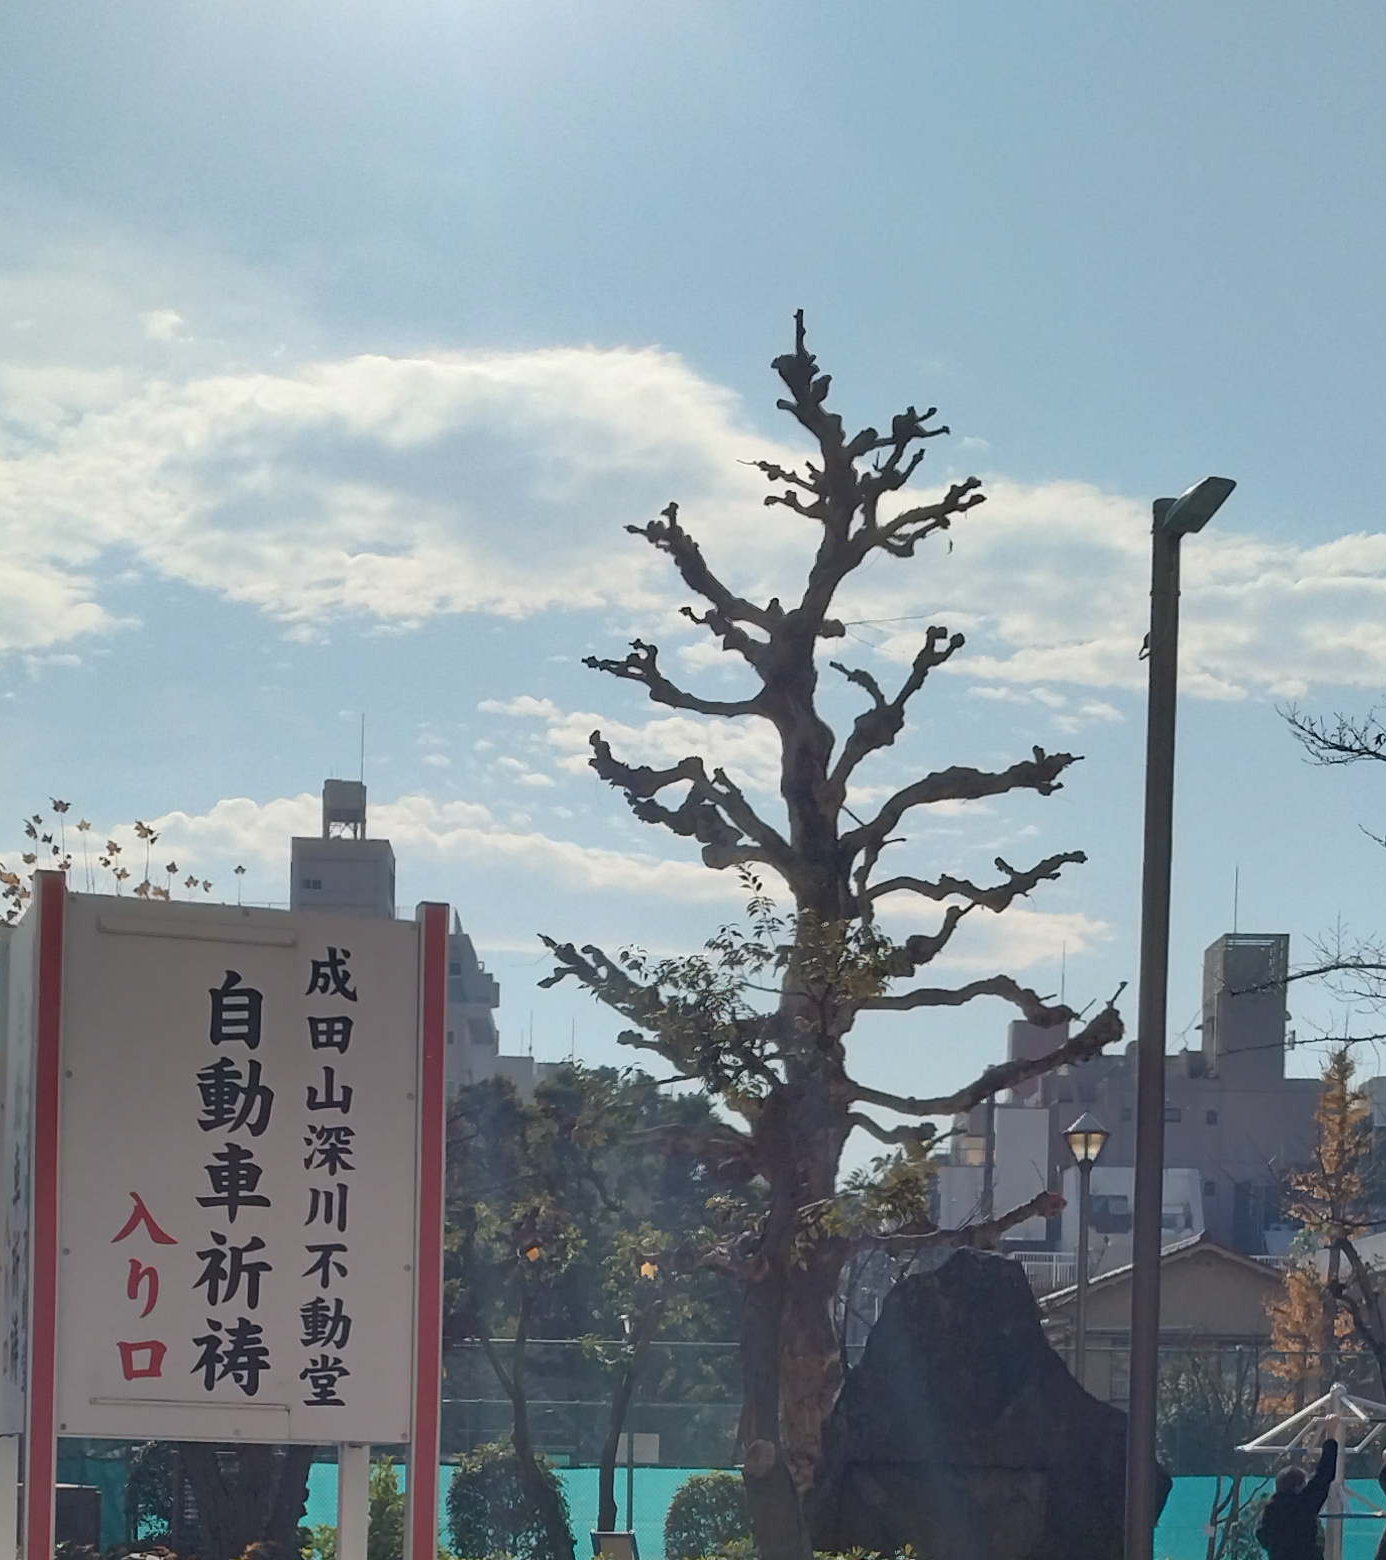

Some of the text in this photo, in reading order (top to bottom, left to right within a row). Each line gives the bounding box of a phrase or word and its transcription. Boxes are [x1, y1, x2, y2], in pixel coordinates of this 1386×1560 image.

[111, 1191, 179, 1382] 入り口
[189, 969, 275, 1397] 自動車祈祷
[298, 946, 359, 1408] 成田山深川不動堂
